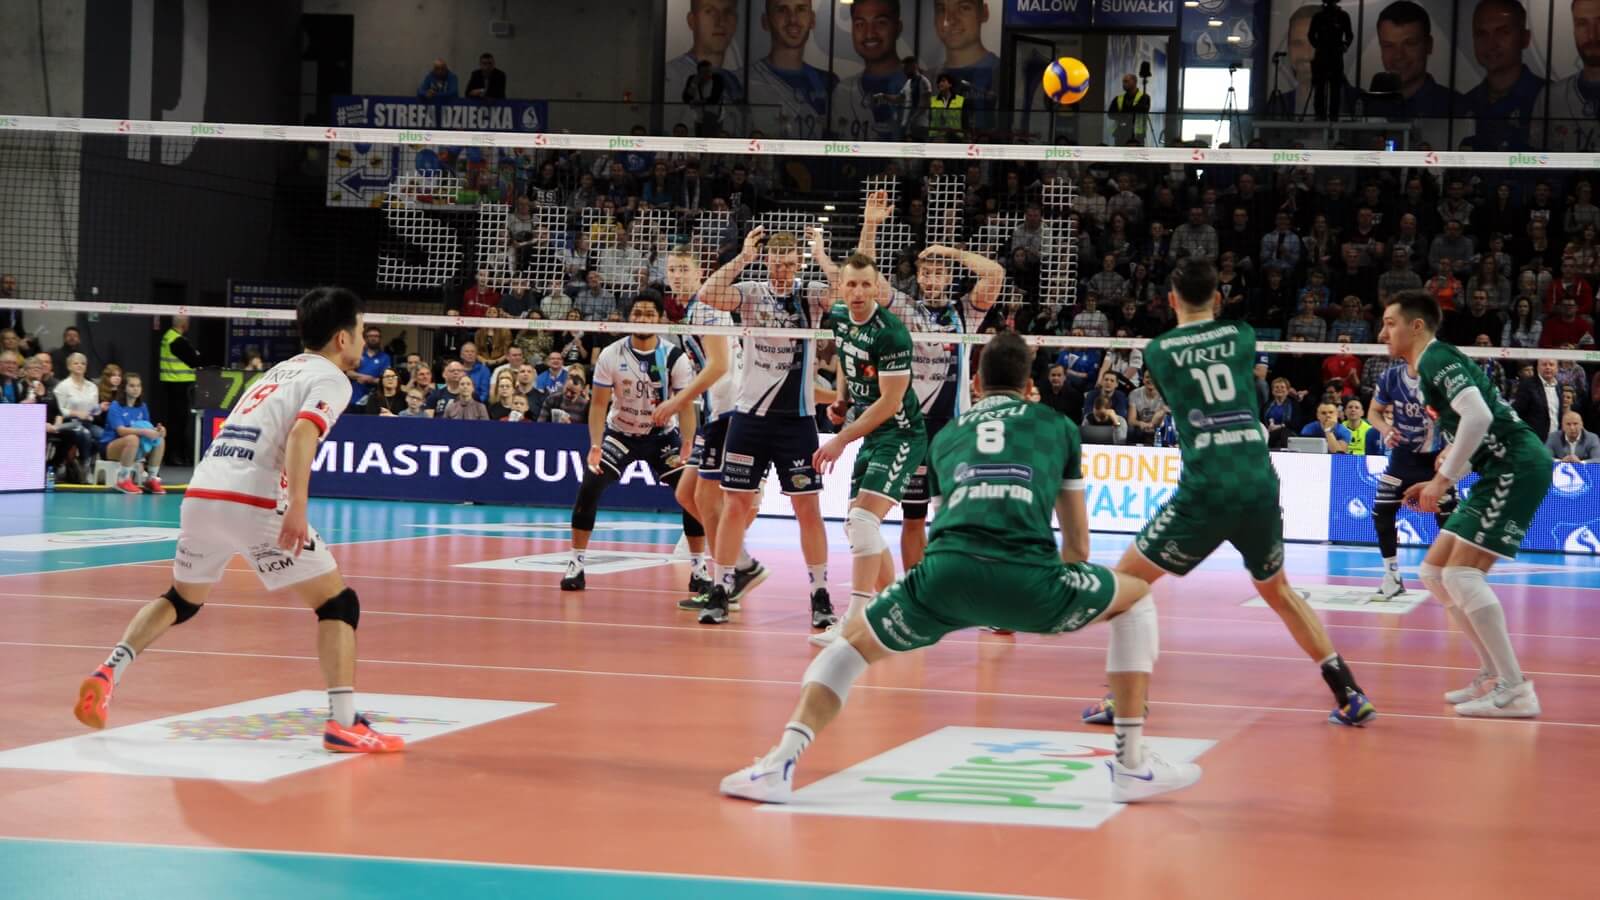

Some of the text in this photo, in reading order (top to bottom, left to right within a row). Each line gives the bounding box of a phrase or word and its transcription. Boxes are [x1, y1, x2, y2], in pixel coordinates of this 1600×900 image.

[1017, 0, 1077, 12] MALOW
[1102, 0, 1174, 13] SUWAŁKI
[374, 103, 436, 127] STREFA
[441, 105, 514, 129] DZIECKA
[191, 124, 215, 136] plus
[399, 130, 423, 142] plus
[609, 136, 634, 149] plus
[824, 142, 850, 154] plus
[1045, 146, 1072, 159] plus
[1273, 151, 1300, 163] plus
[1509, 153, 1538, 167] plus
[1171, 341, 1236, 368] VIRTU
[845, 355, 857, 377] 5
[636, 380, 650, 399] 91
[1189, 363, 1236, 405] 10
[957, 404, 1028, 427] VIRTU
[1406, 402, 1423, 418] 82
[976, 420, 1005, 454] 8
[1213, 429, 1263, 446] aluron
[968, 482, 1033, 506] aluron
[1084, 483, 1172, 520] AŁK
[861, 756, 1095, 811] plus
